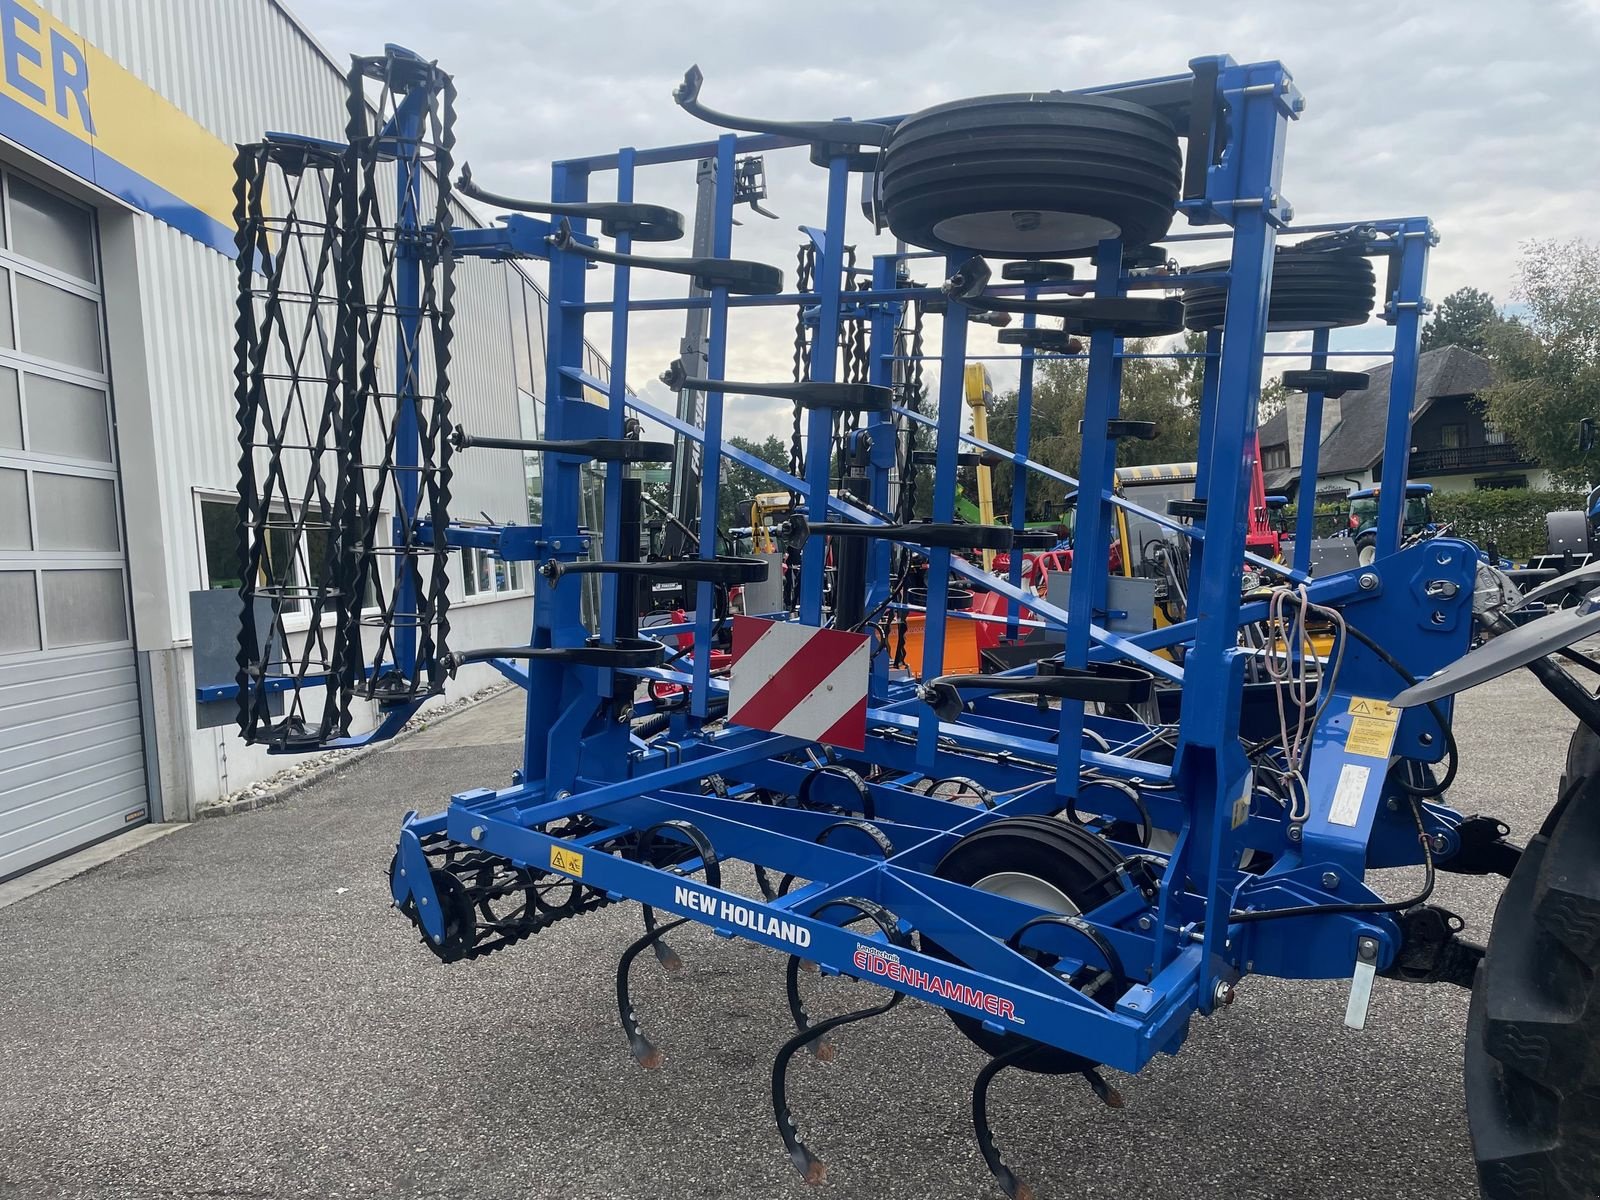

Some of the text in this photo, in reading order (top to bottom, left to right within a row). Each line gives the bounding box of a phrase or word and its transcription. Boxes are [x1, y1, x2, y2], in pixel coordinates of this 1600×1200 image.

[0, 0, 97, 137] ER
[674, 885, 811, 948] NEW HOLLAND
[856, 941, 900, 962] Landtechnik
[853, 950, 1015, 1020] EIDENHAMMER
